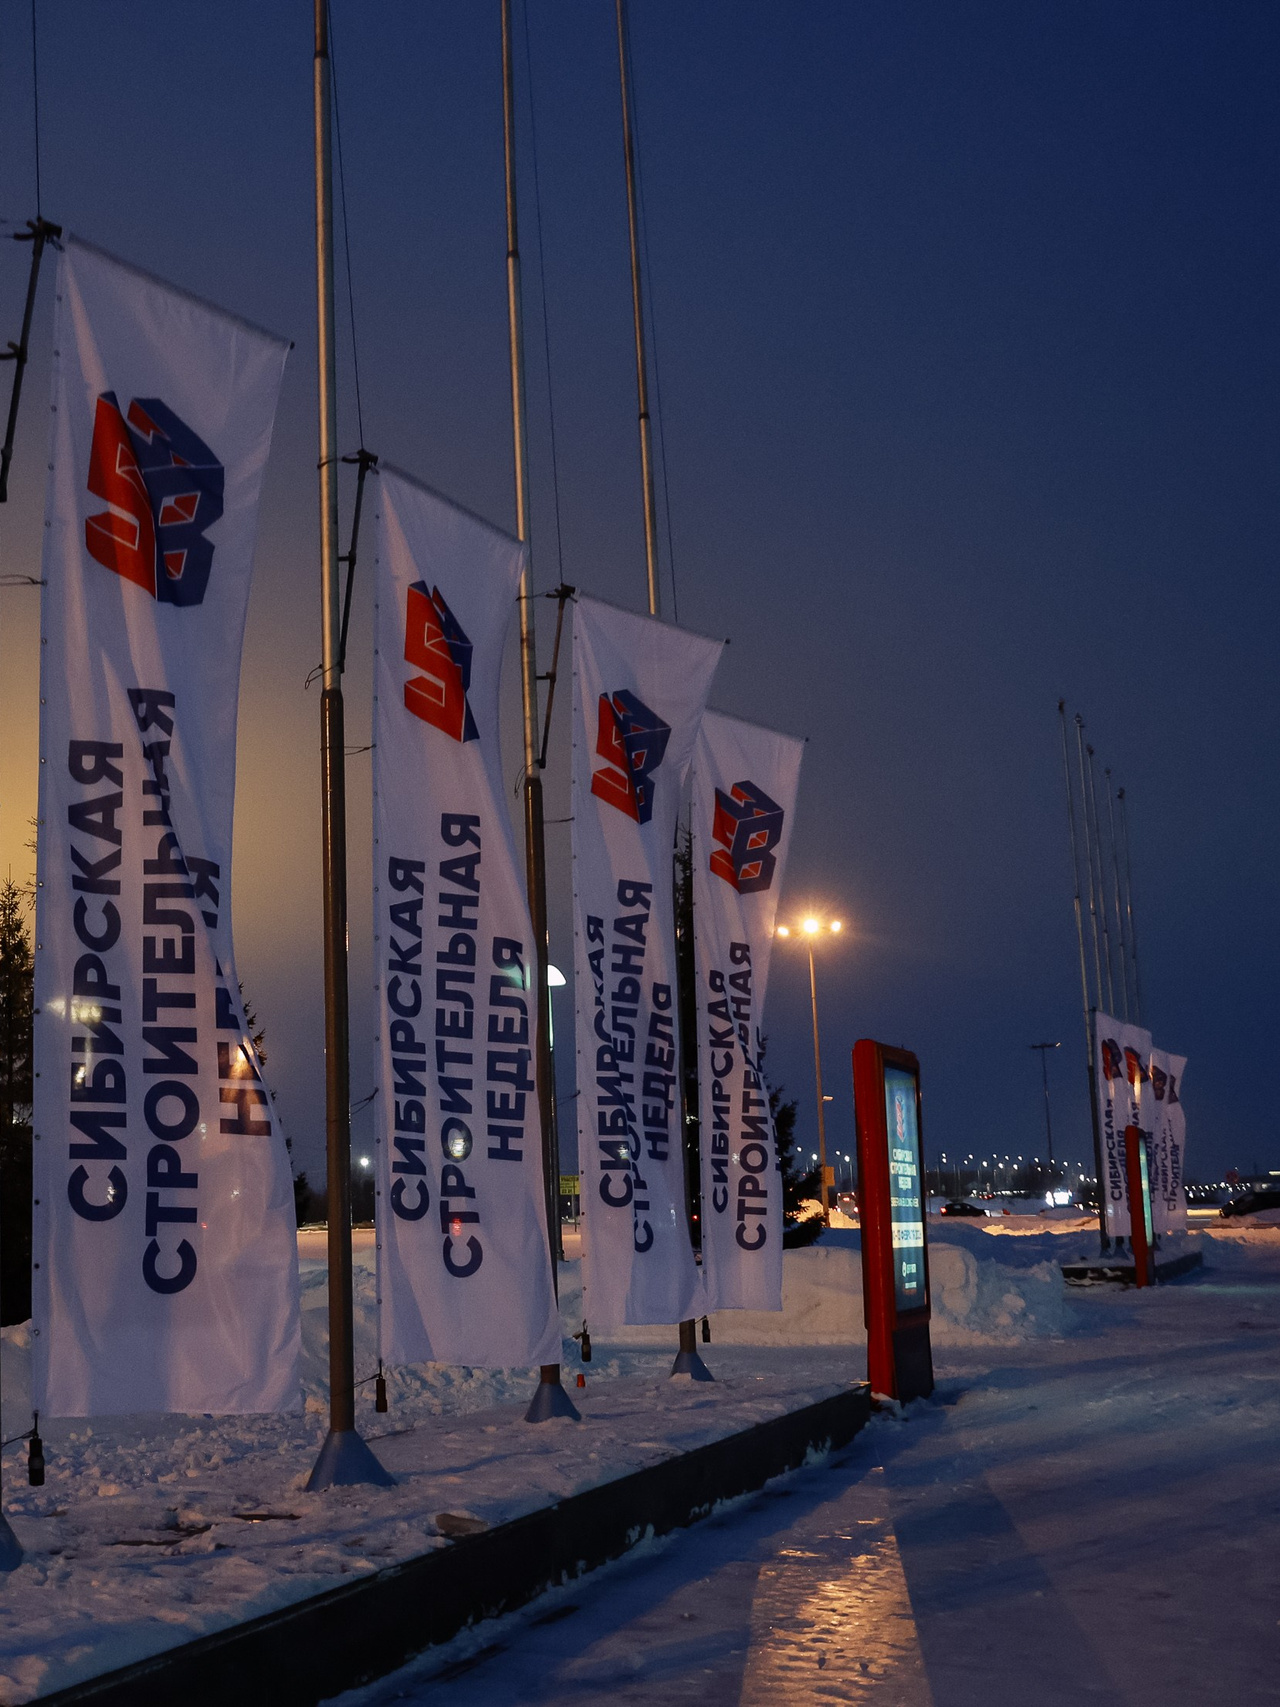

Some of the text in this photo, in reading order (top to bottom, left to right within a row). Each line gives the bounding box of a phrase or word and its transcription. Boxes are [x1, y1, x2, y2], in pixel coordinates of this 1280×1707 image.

[67, 739, 128, 1222] СИБИРСКАЯ
[388, 856, 430, 1222] СИБИРСКАЯ
[435, 812, 483, 1278] СТРОИТЕЛЬНАЯ
[487, 936, 535, 1162] НЕДЕЛЯ
